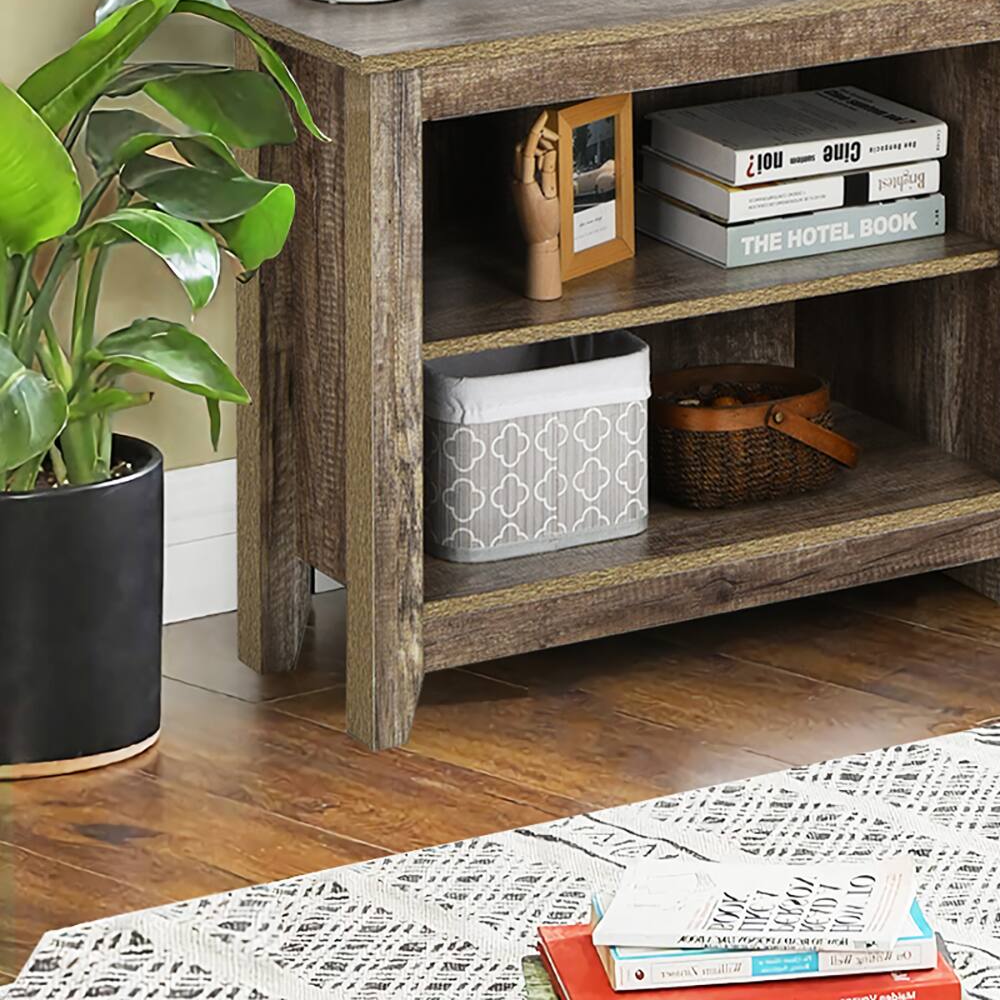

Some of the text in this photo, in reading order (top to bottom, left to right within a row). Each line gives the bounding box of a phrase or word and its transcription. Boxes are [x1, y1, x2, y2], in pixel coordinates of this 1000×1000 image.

[823, 141, 862, 162] Cine
[746, 151, 783, 177] noi?
[878, 170, 926, 192] Brightest
[740, 210, 919, 256] THE HOTEL BOOK
